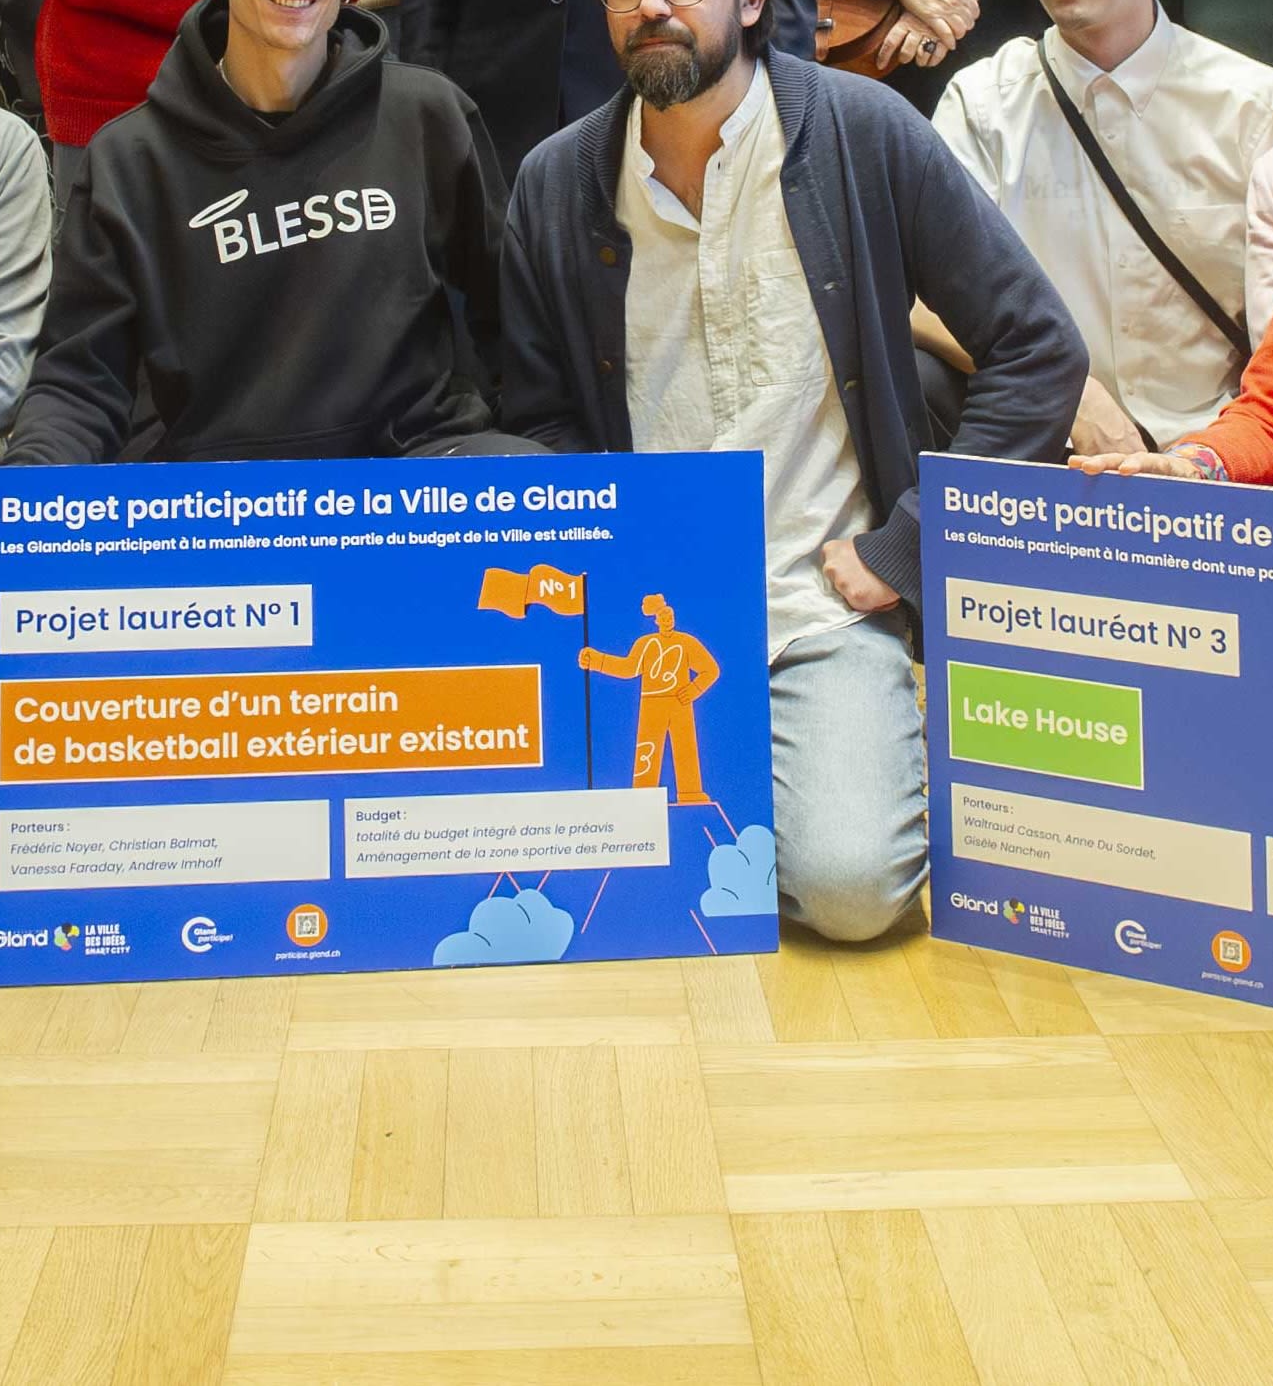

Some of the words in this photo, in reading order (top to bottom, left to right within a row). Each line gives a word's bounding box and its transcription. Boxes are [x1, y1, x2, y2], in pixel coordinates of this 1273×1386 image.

[2, 496, 118, 530] Budget
[128, 489, 307, 528] participatif
[315, 490, 355, 515] de
[364, 489, 392, 514] la
[400, 487, 468, 513] Ville
[475, 486, 516, 512] de
[523, 484, 616, 510] Gland
[945, 487, 1047, 526] Budget
[1055, 503, 1224, 542] participatif
[1232, 518, 1272, 546] de
[0, 542, 24, 554] Les
[27, 539, 92, 553] Glandois
[96, 538, 176, 555] participent
[179, 537, 189, 550] à
[192, 537, 206, 549] la
[209, 535, 271, 549] manière
[273, 535, 307, 547] dont
[310, 536, 338, 546] une
[341, 532, 384, 549] partie
[386, 532, 405, 544] du
[409, 532, 460, 547] budget
[463, 531, 482, 543] de
[485, 530, 498, 542] la
[501, 529, 532, 542] Ville
[534, 529, 556, 541] est
[559, 527, 613, 540] utilisée.
[945, 530, 965, 542] Les
[968, 532, 1024, 549] Glandois
[1028, 541, 1100, 558] participent
[1104, 547, 1112, 560] à
[1116, 549, 1128, 562] la
[1132, 554, 1189, 569] manière
[1192, 559, 1225, 574] dont
[1228, 565, 1255, 576] une
[568, 581, 576, 599] 1
[17, 606, 109, 635] Projet
[120, 602, 236, 630] lauréat
[290, 602, 298, 625] 1
[962, 596, 1042, 632] Projet
[1051, 607, 1158, 644] lauréat
[1211, 629, 1226, 654] 3
[15, 695, 200, 722] Couverture
[290, 685, 398, 714] terrain
[964, 697, 1028, 728] Lake
[1036, 708, 1128, 744] House
[14, 738, 56, 764] de
[65, 732, 238, 763] basketball
[247, 728, 392, 758] extérieur
[400, 724, 528, 752] existant
[11, 842, 62, 854] Frédéric
[66, 842, 104, 854] Noyer,
[109, 839, 166, 851] Christian
[170, 838, 218, 848] Balmat,
[357, 830, 400, 842] totalité
[404, 830, 420, 840] du
[424, 828, 468, 840] budget
[473, 826, 516, 839] intégré
[520, 825, 550, 836] dans
[555, 824, 565, 834] le
[568, 822, 614, 836] préavis
[964, 816, 1014, 833] Waltraud
[1018, 826, 1061, 843] Casson,
[1064, 834, 1094, 848] Anne
[1097, 840, 1113, 851] Du
[1116, 844, 1156, 860] Sordet,
[964, 836, 997, 849] Gisèle
[1000, 842, 1050, 860] Nanchen
[11, 865, 66, 875] Vanessa
[70, 862, 124, 874] Faraday,
[129, 860, 178, 870] Andrew
[356, 850, 451, 863] Aménagement
[455, 849, 471, 858] de
[475, 848, 486, 858] la
[490, 848, 518, 857] zone
[523, 845, 571, 858] sportive
[576, 844, 597, 854] des
[951, 893, 998, 914] Gland
